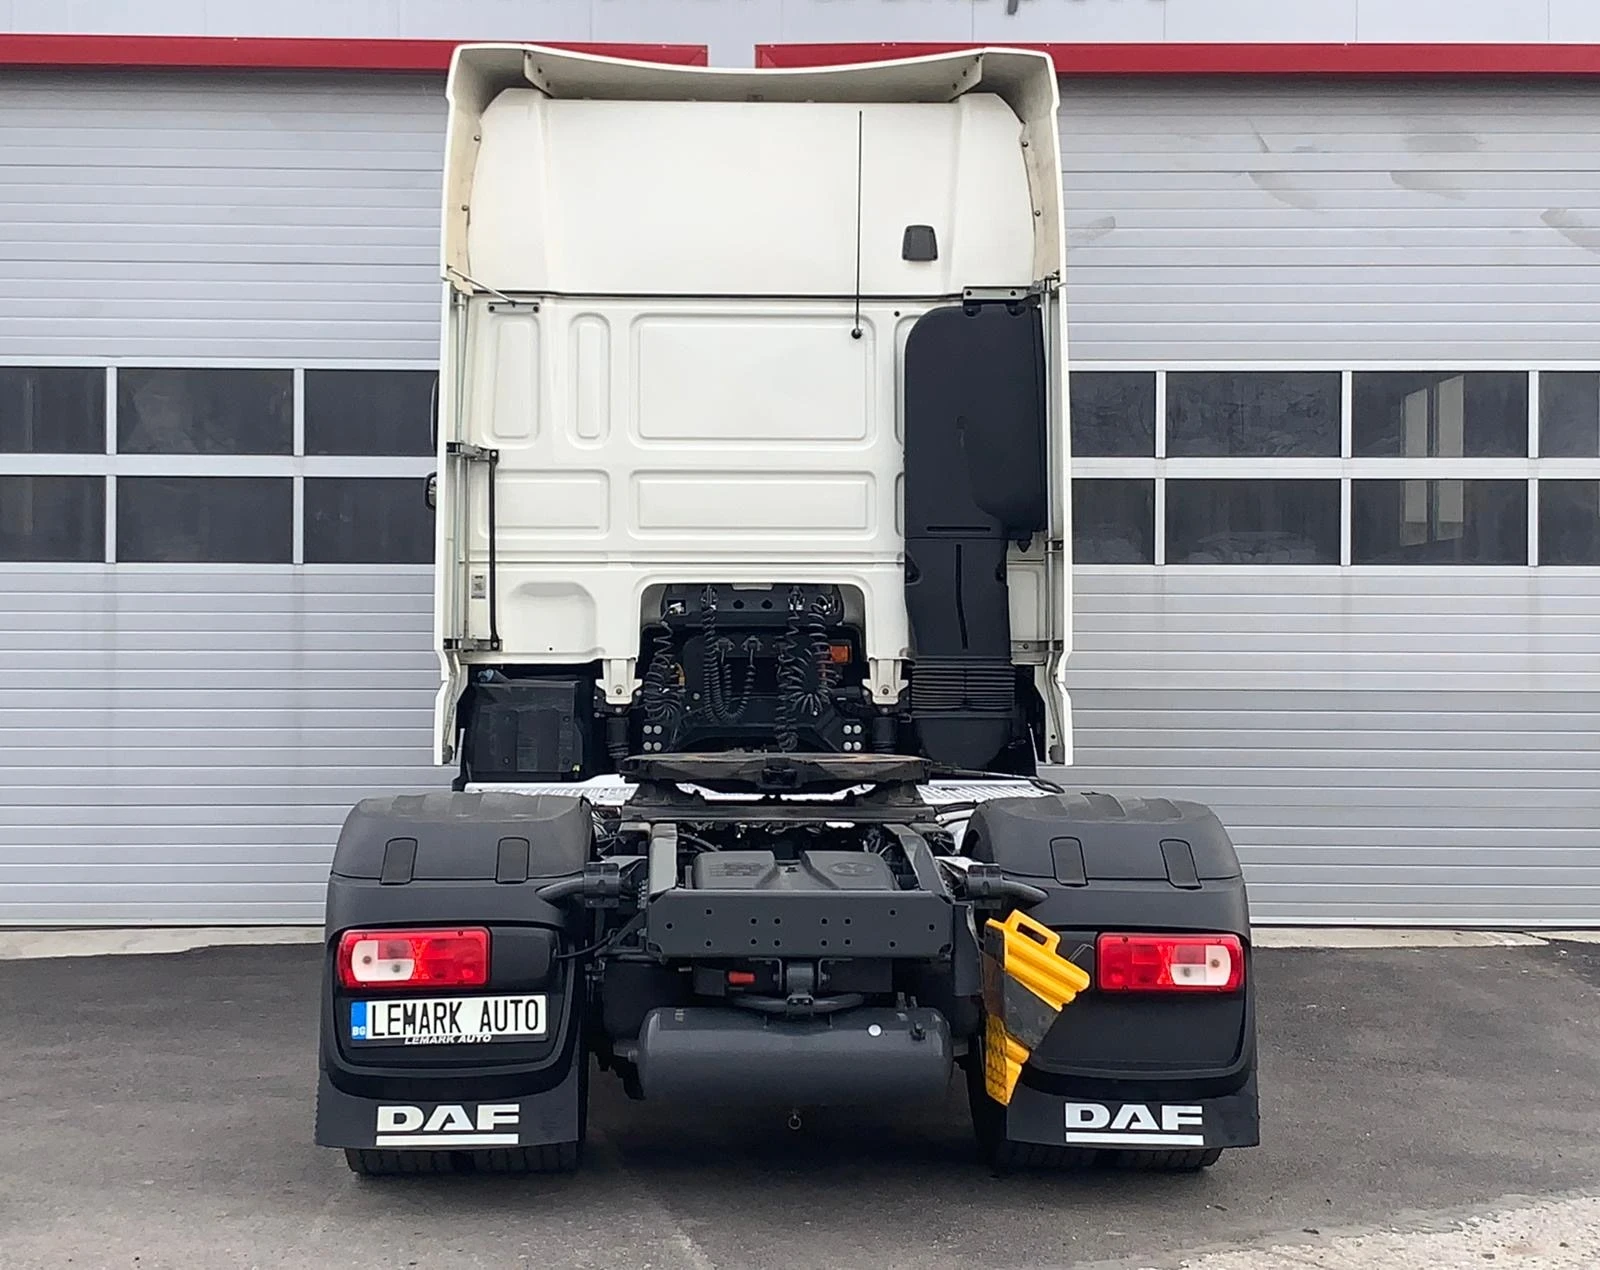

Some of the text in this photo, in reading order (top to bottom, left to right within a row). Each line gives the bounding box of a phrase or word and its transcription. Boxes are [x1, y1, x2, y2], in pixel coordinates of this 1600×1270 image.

[352, 1025, 366, 1036] BG
[371, 999, 539, 1037] LEMARK AUTO
[404, 1033, 492, 1046] LEMARK AUTO
[376, 1103, 520, 1132] DAF
[1064, 1102, 1203, 1131] DAF
